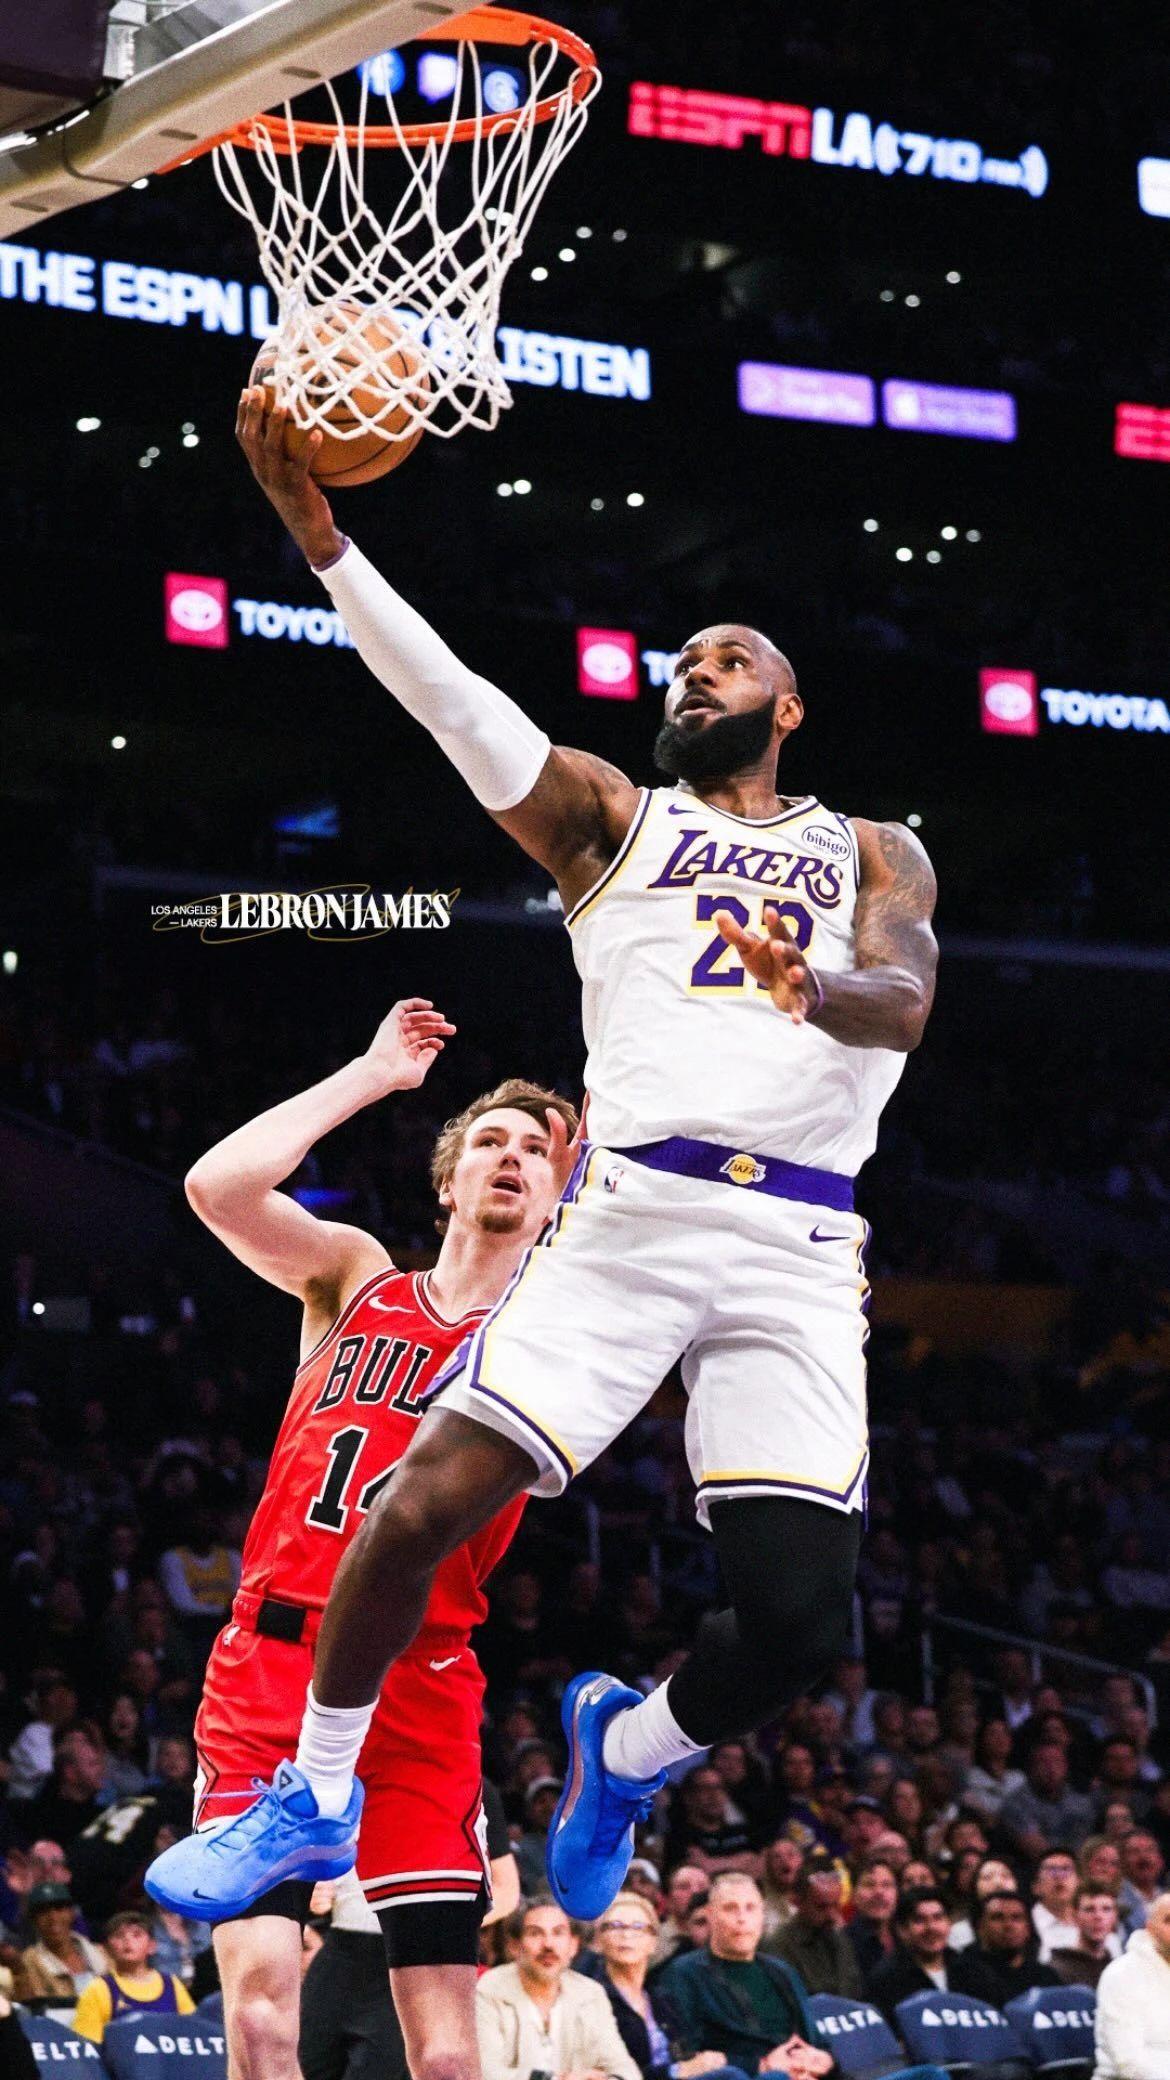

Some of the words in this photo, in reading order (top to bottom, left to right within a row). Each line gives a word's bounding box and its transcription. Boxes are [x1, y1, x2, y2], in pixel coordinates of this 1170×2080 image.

[0, 242, 96, 311] THE
[102, 260, 244, 335] ESPN
[496, 325, 651, 401] ISTEN
[232, 598, 357, 648] TOYOT
[1040, 687, 1170, 734] TOYOTA
[806, 831, 848, 855] bibigo
[646, 829, 844, 910] LAKERS
[312, 1334, 430, 1418] BUL
[1051, 2010, 1097, 2028] DEL
[31, 2041, 100, 2060] ELTA
[158, 2035, 225, 2056] DELT
